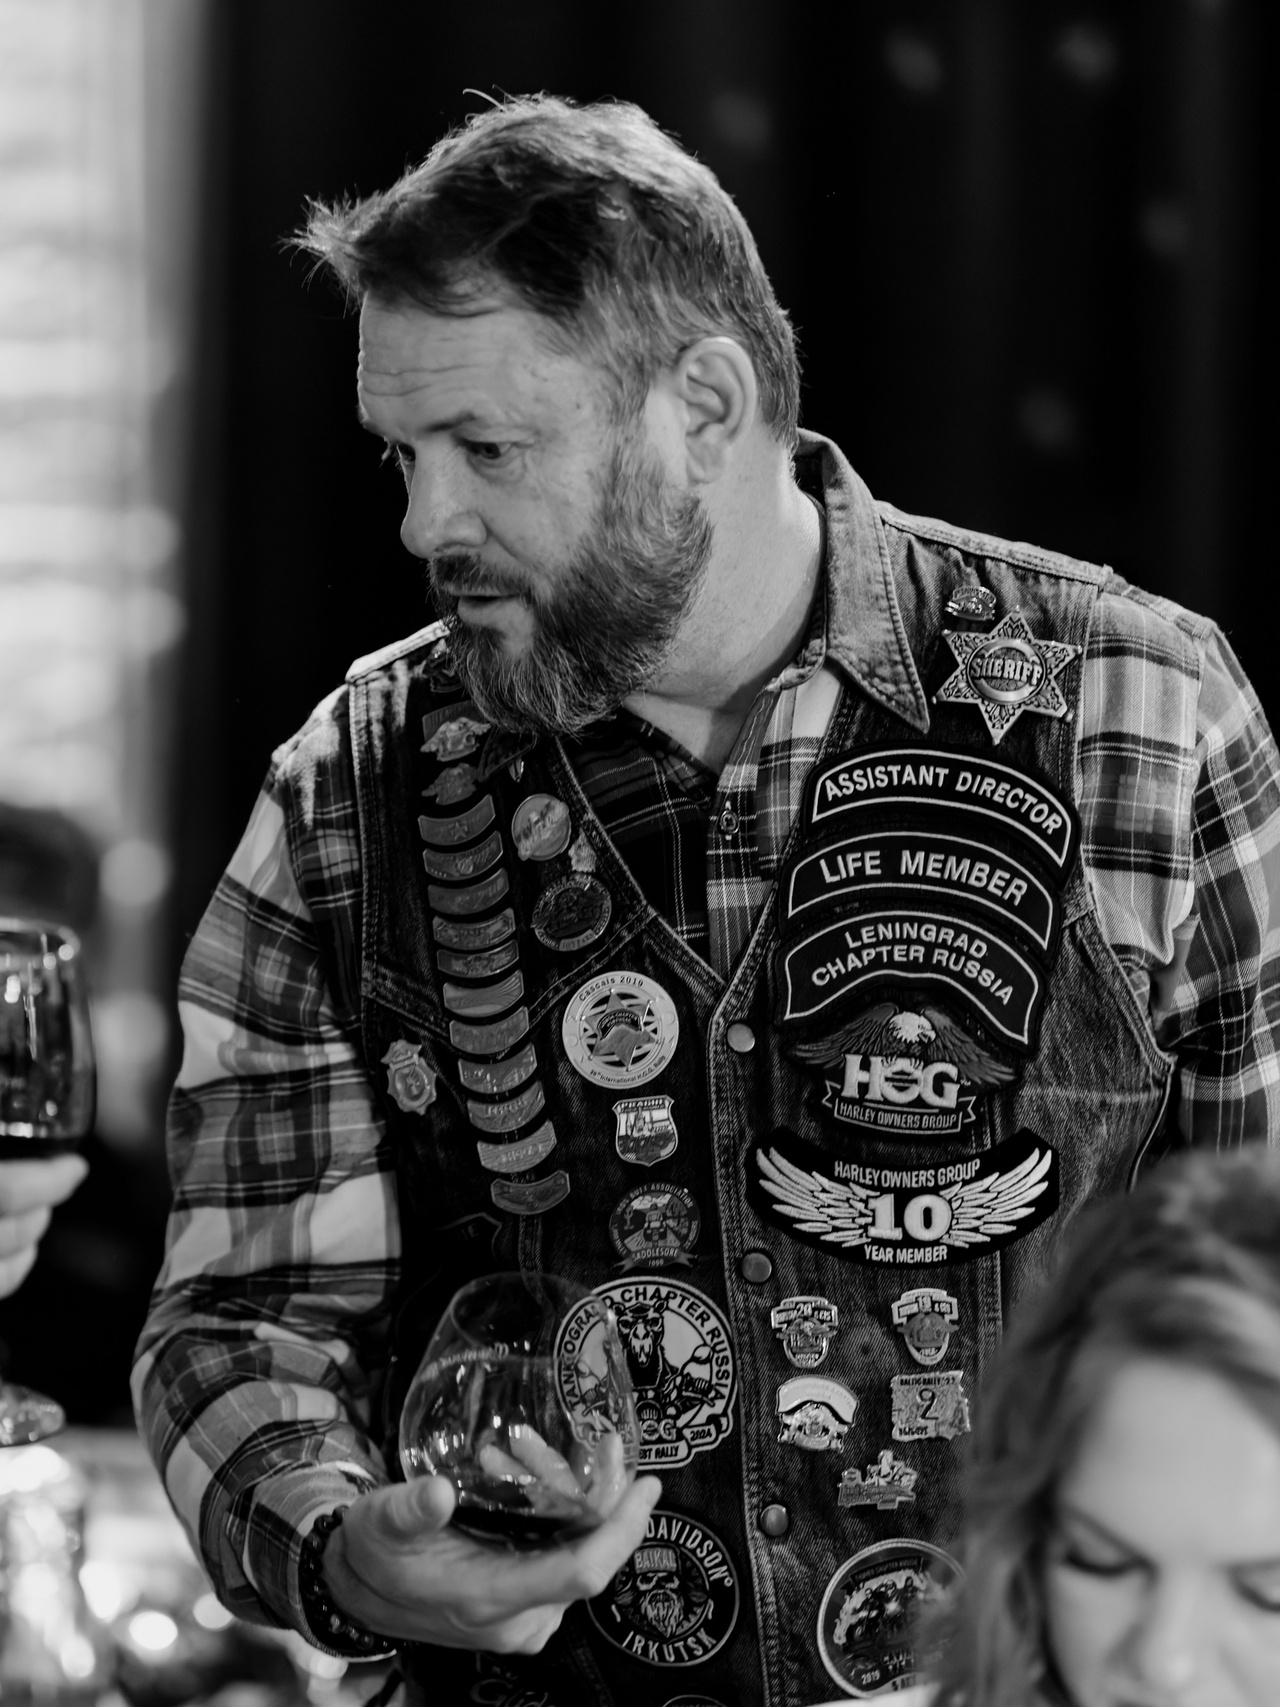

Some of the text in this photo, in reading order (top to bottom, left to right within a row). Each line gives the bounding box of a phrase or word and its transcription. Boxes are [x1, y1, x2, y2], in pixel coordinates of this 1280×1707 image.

[969, 656, 1043, 687] SHERIFF
[824, 764, 1063, 836] ASSISTANT DIRECTOR
[820, 850, 1028, 906] LIFE MEMBER
[845, 922, 988, 958] LENINGRAD
[579, 977, 616, 1001] Cascais
[811, 945, 1014, 1005] CHAPTER RUSSIA
[839, 1102, 957, 1129] HARLEY OWNERS GROUP
[834, 1158, 981, 1188] HARLEY OWNERS GROUP
[650, 1183, 694, 1208] ASSOCIATION
[867, 1193, 952, 1242] 10
[864, 1245, 948, 1264] YEAR MEMBER
[620, 1286, 710, 1328] CHAPTER
[706, 1326, 730, 1406] RUSSIA
[654, 1445, 679, 1459] RALLY
[634, 1549, 677, 1569] BAIKAL
[622, 1630, 717, 1663] IRKUTSK
